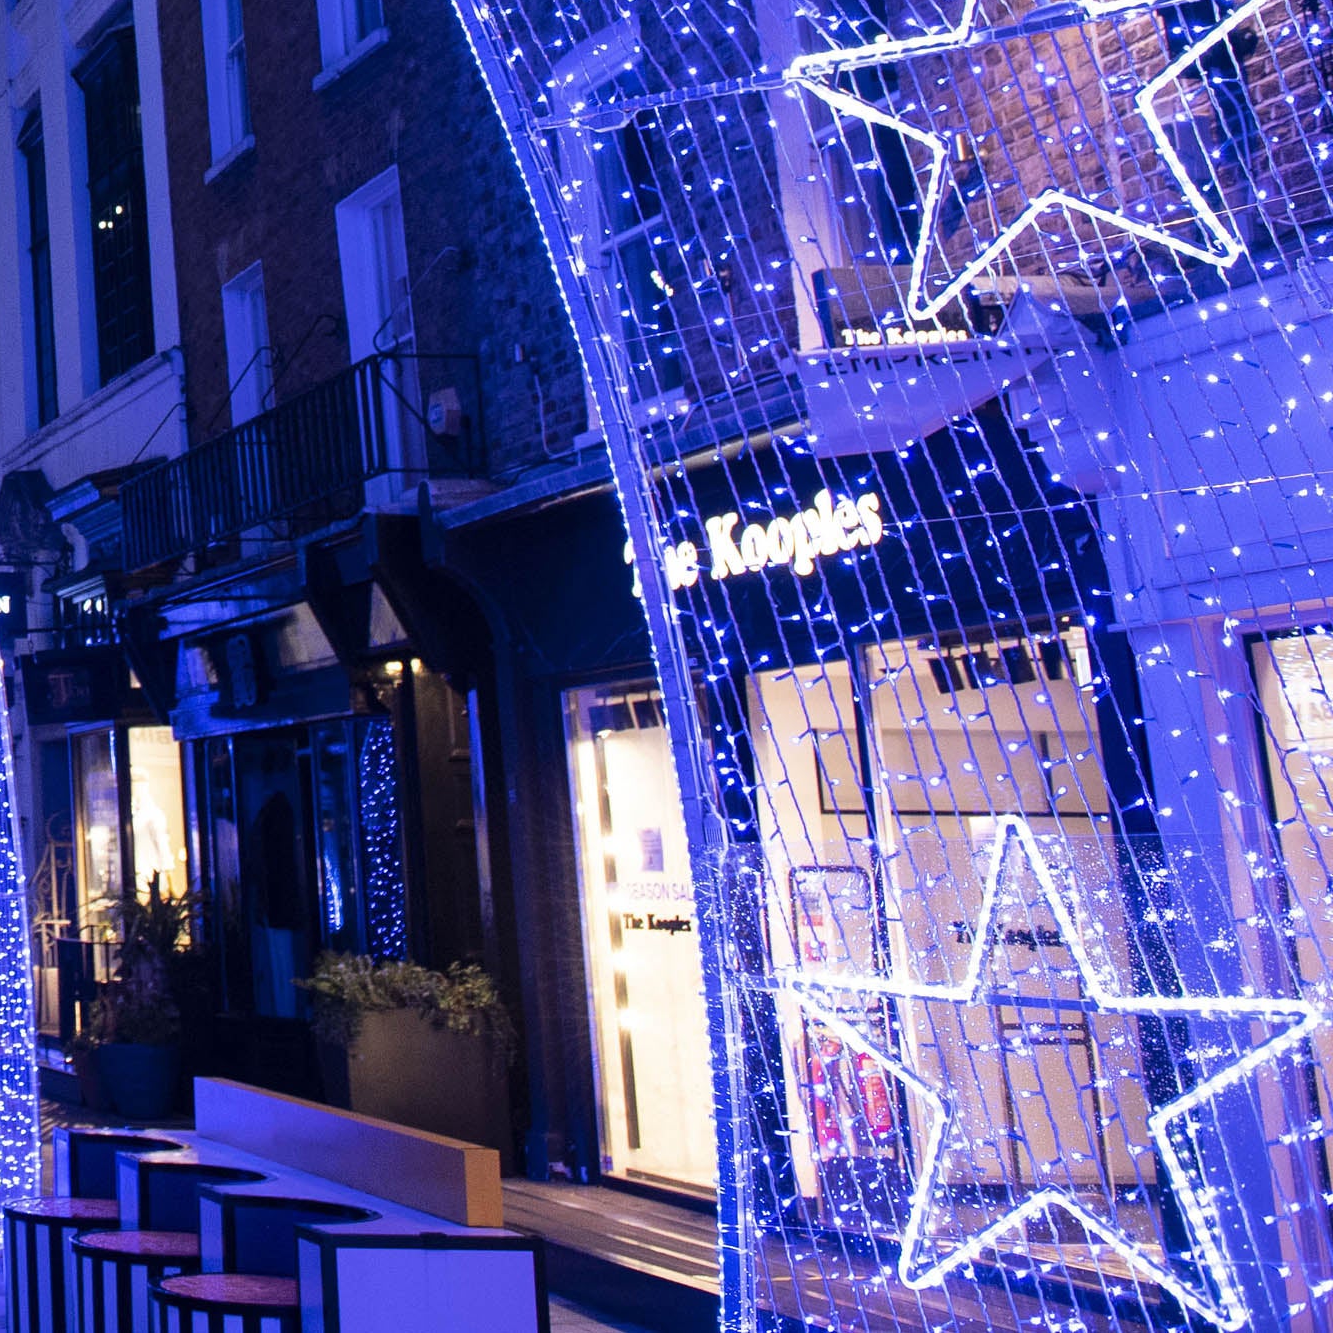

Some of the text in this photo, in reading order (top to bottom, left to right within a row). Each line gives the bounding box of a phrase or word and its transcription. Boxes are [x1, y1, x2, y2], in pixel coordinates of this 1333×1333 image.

[841, 328, 881, 346] The
[705, 488, 884, 579] Kooples
[623, 913, 644, 930] The
